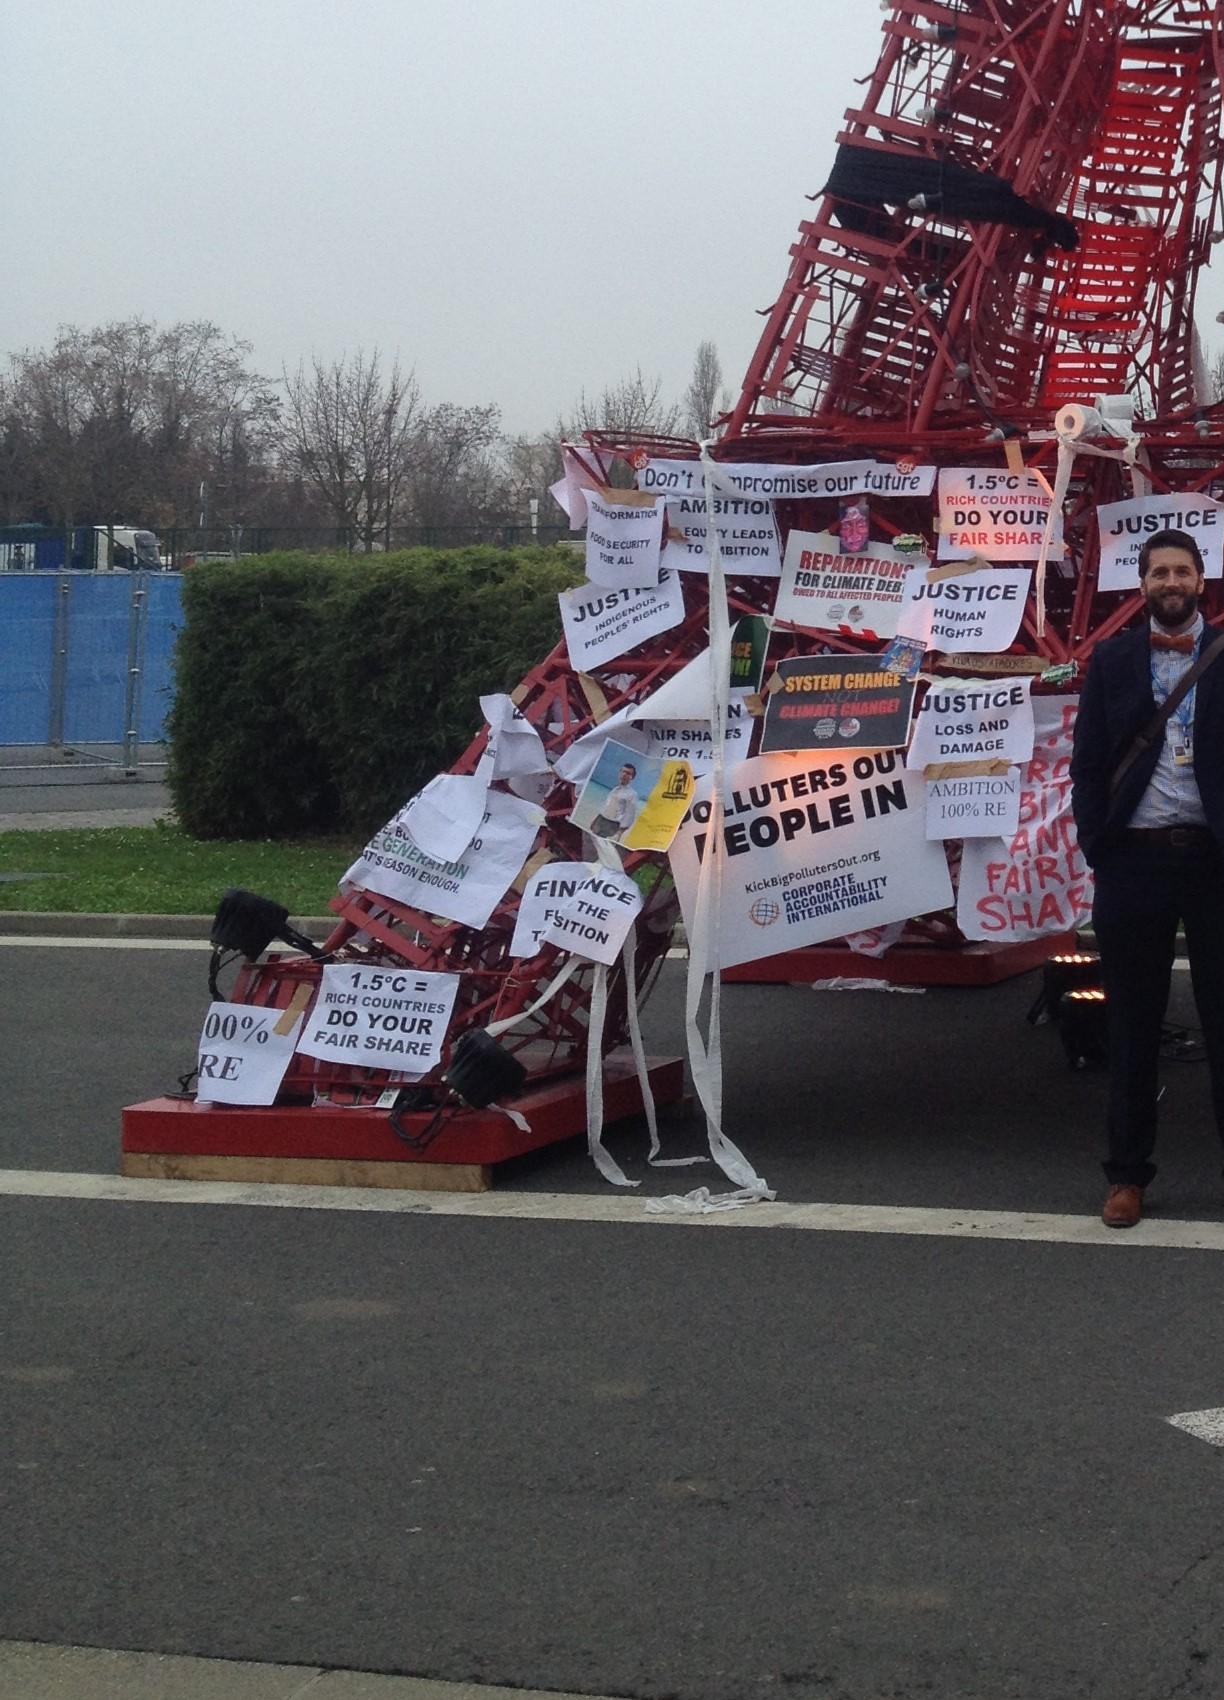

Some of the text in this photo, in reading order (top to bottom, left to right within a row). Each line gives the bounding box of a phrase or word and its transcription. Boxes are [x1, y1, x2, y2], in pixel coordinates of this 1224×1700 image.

[645, 468, 693, 488] Don't
[825, 475, 858, 491] our
[864, 470, 920, 490] future
[592, 501, 657, 519] TRFORMATION
[680, 499, 770, 514] AMBITIO
[946, 495, 1052, 507] RICH COUNTRIE
[954, 510, 1049, 525] DO YOUR
[1110, 508, 1217, 535] JUSTICE
[606, 539, 650, 549] SECURITY
[684, 527, 774, 539] EQUY LEADS
[949, 532, 1055, 546] FAIR SHAR
[600, 552, 634, 565] FOR ALL
[687, 544, 703, 554] TO
[795, 571, 904, 594] FOR CLIMATE DEB
[912, 583, 1018, 602] JUSTICE
[573, 568, 671, 622] JUSTE
[595, 596, 656, 632] INDIGENOUS
[633, 601, 670, 625] RIGHTS
[933, 608, 987, 622] HUMAN
[930, 625, 983, 639] RIGHTS
[785, 671, 901, 693] SYSTEM CHANGE
[780, 698, 900, 718] CLIMATE CHANGE!
[921, 686, 1025, 713] JUSTICE
[681, 728, 741, 741] SHAES
[935, 719, 1010, 736] LOSS AND
[940, 738, 1005, 755] DAMAGE
[680, 764, 847, 831] OLUTERS
[860, 779, 908, 819] IN
[930, 781, 1015, 797] AMBITION
[941, 802, 1008, 819] 100% RE
[418, 870, 460, 895] ENOUGH.
[745, 850, 881, 894] KickBigPollutersOut.org
[535, 878, 636, 905] FINNCE
[782, 873, 856, 902] CORPORATE
[785, 876, 888, 913] ACCOUNTABILITY
[577, 900, 609, 921] THE
[787, 891, 884, 924] INTERNATIONAL
[976, 886, 1093, 931] SHAR
[325, 992, 446, 1015] RICH COUNTRIES
[204, 1012, 269, 1044] 00%
[326, 1009, 433, 1036] DO YOUR
[313, 1030, 433, 1057] FAIR SHARE
[199, 1053, 243, 1081] RE
